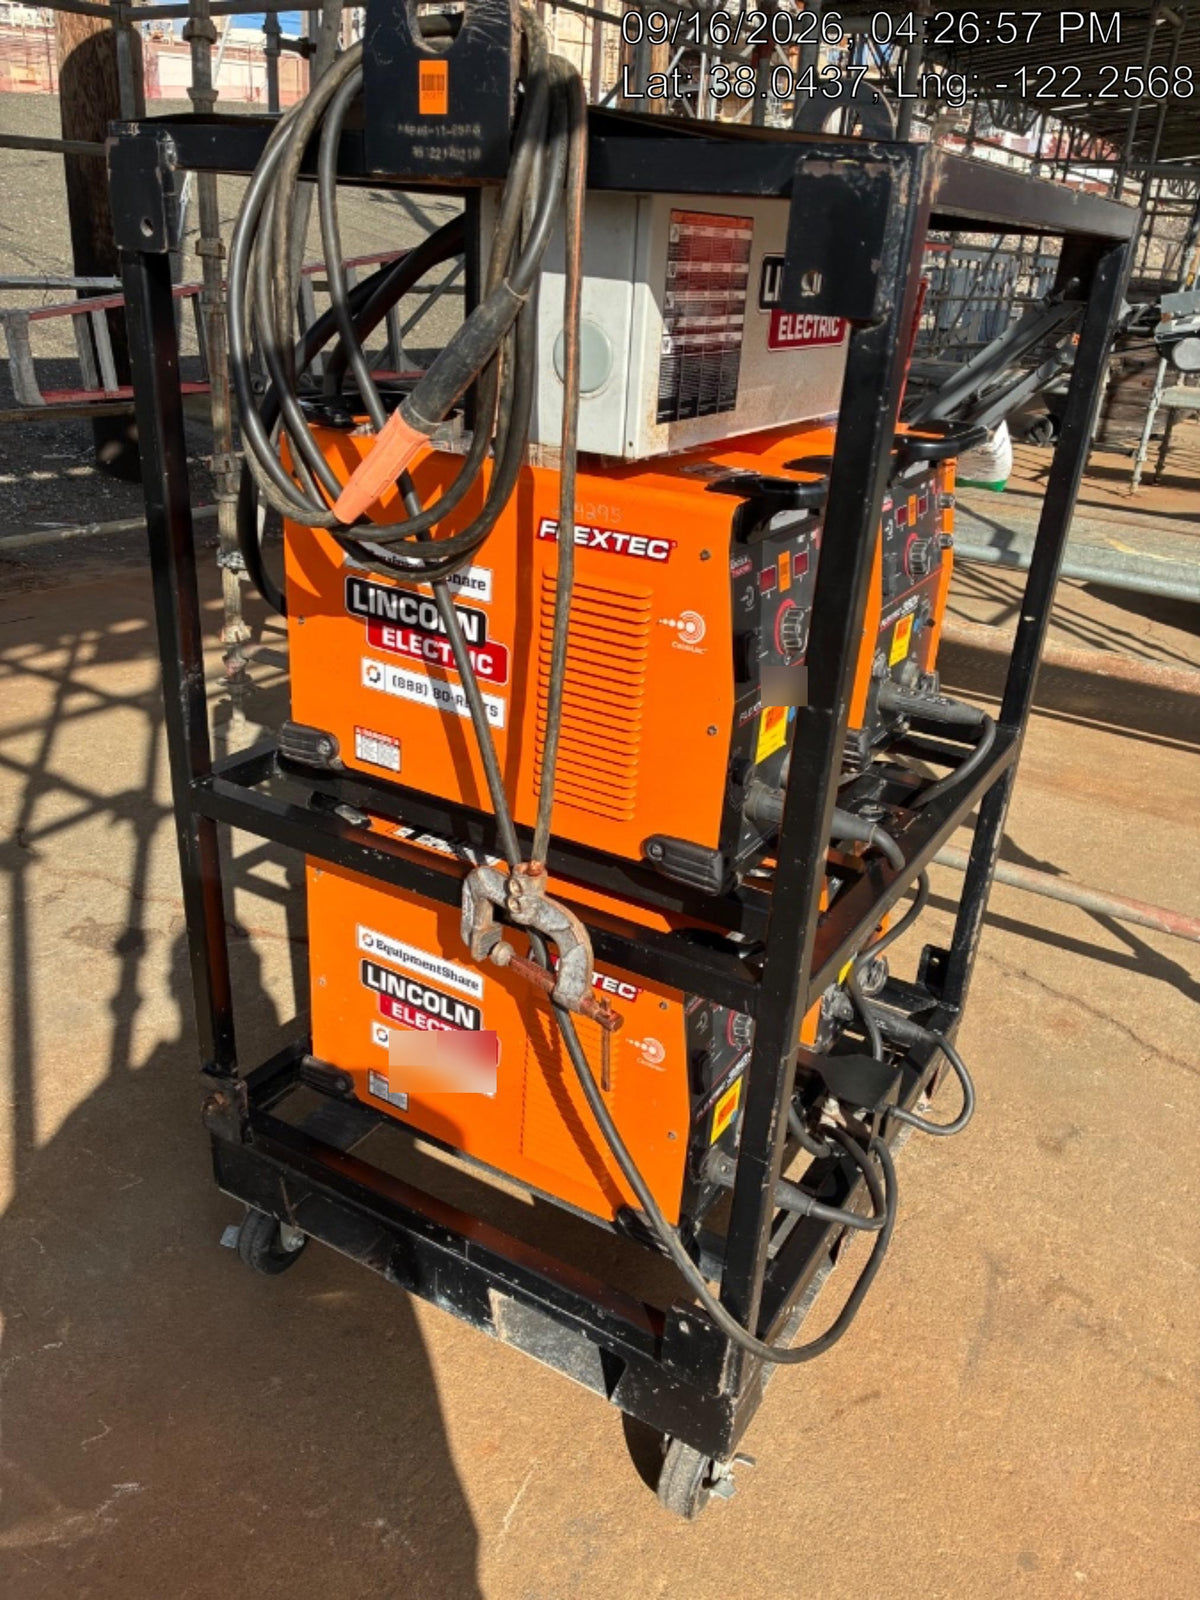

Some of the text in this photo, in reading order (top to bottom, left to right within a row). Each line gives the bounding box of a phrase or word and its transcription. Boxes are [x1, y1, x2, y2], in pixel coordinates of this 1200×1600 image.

[777, 314, 841, 342] ELECTRIC
[381, 625, 493, 675] ELECTIC
[392, 674, 428, 697] (888)
[375, 937, 480, 992] EquipmentShare
[366, 963, 475, 1031] LINCOLN
